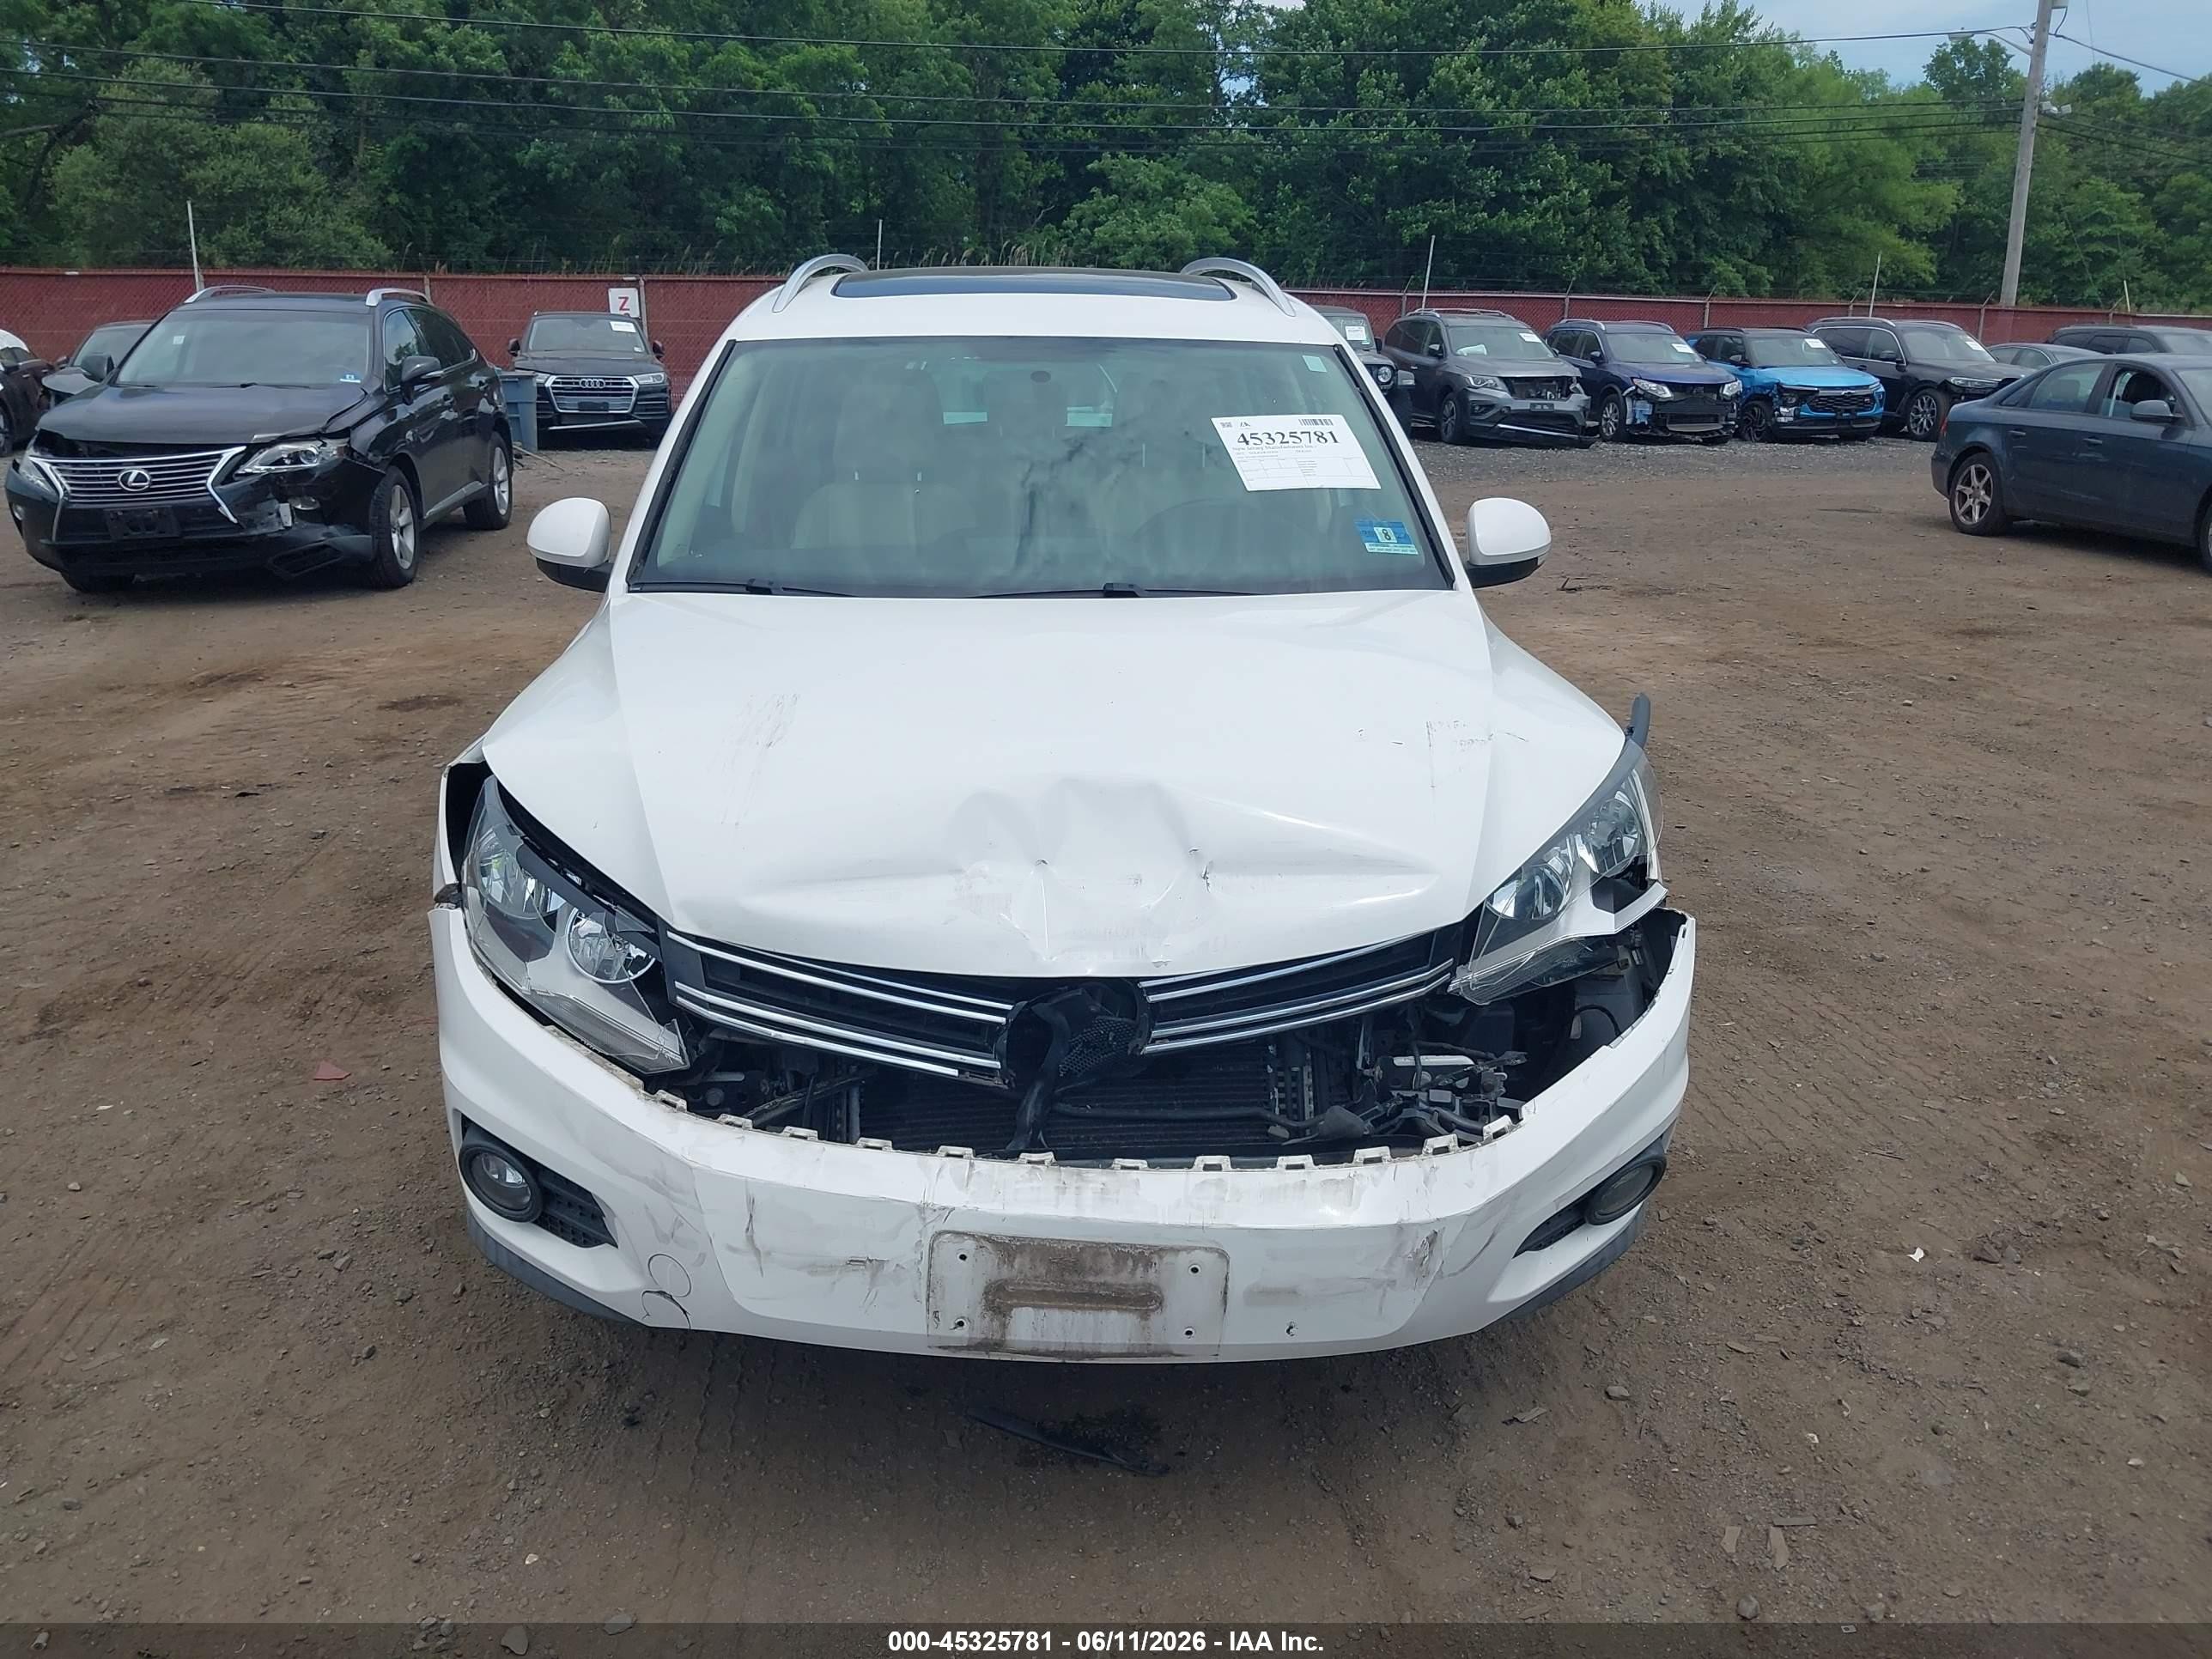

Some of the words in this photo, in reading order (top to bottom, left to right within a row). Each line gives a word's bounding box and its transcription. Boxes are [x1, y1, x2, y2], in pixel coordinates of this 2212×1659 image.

[617, 296, 630, 312] Z
[1237, 431, 1340, 446] 45325781
[1382, 528, 1392, 541] 8
